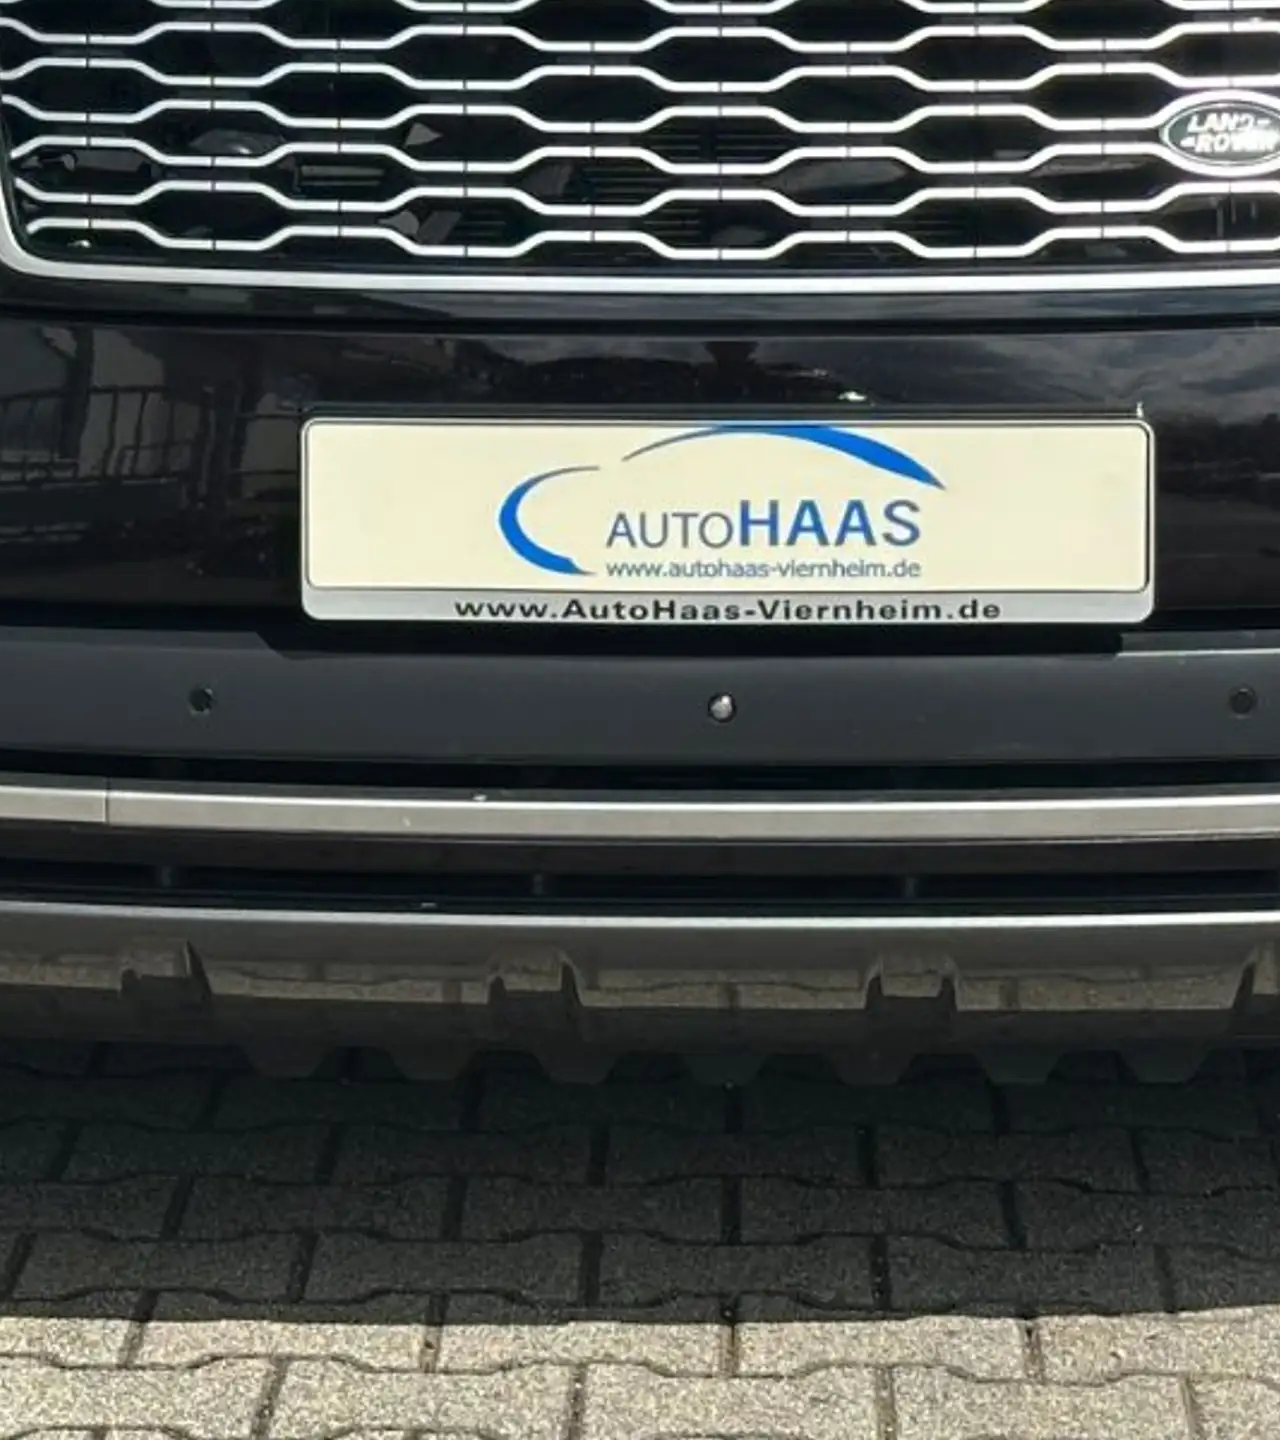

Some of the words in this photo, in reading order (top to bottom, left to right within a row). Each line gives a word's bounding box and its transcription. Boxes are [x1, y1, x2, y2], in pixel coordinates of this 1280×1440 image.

[605, 499, 921, 549] AUTOHAAS
[605, 557, 922, 579] www.autohaas-viernheim.de
[454, 597, 1003, 622] www.AutoHaas-Viernheim.de
